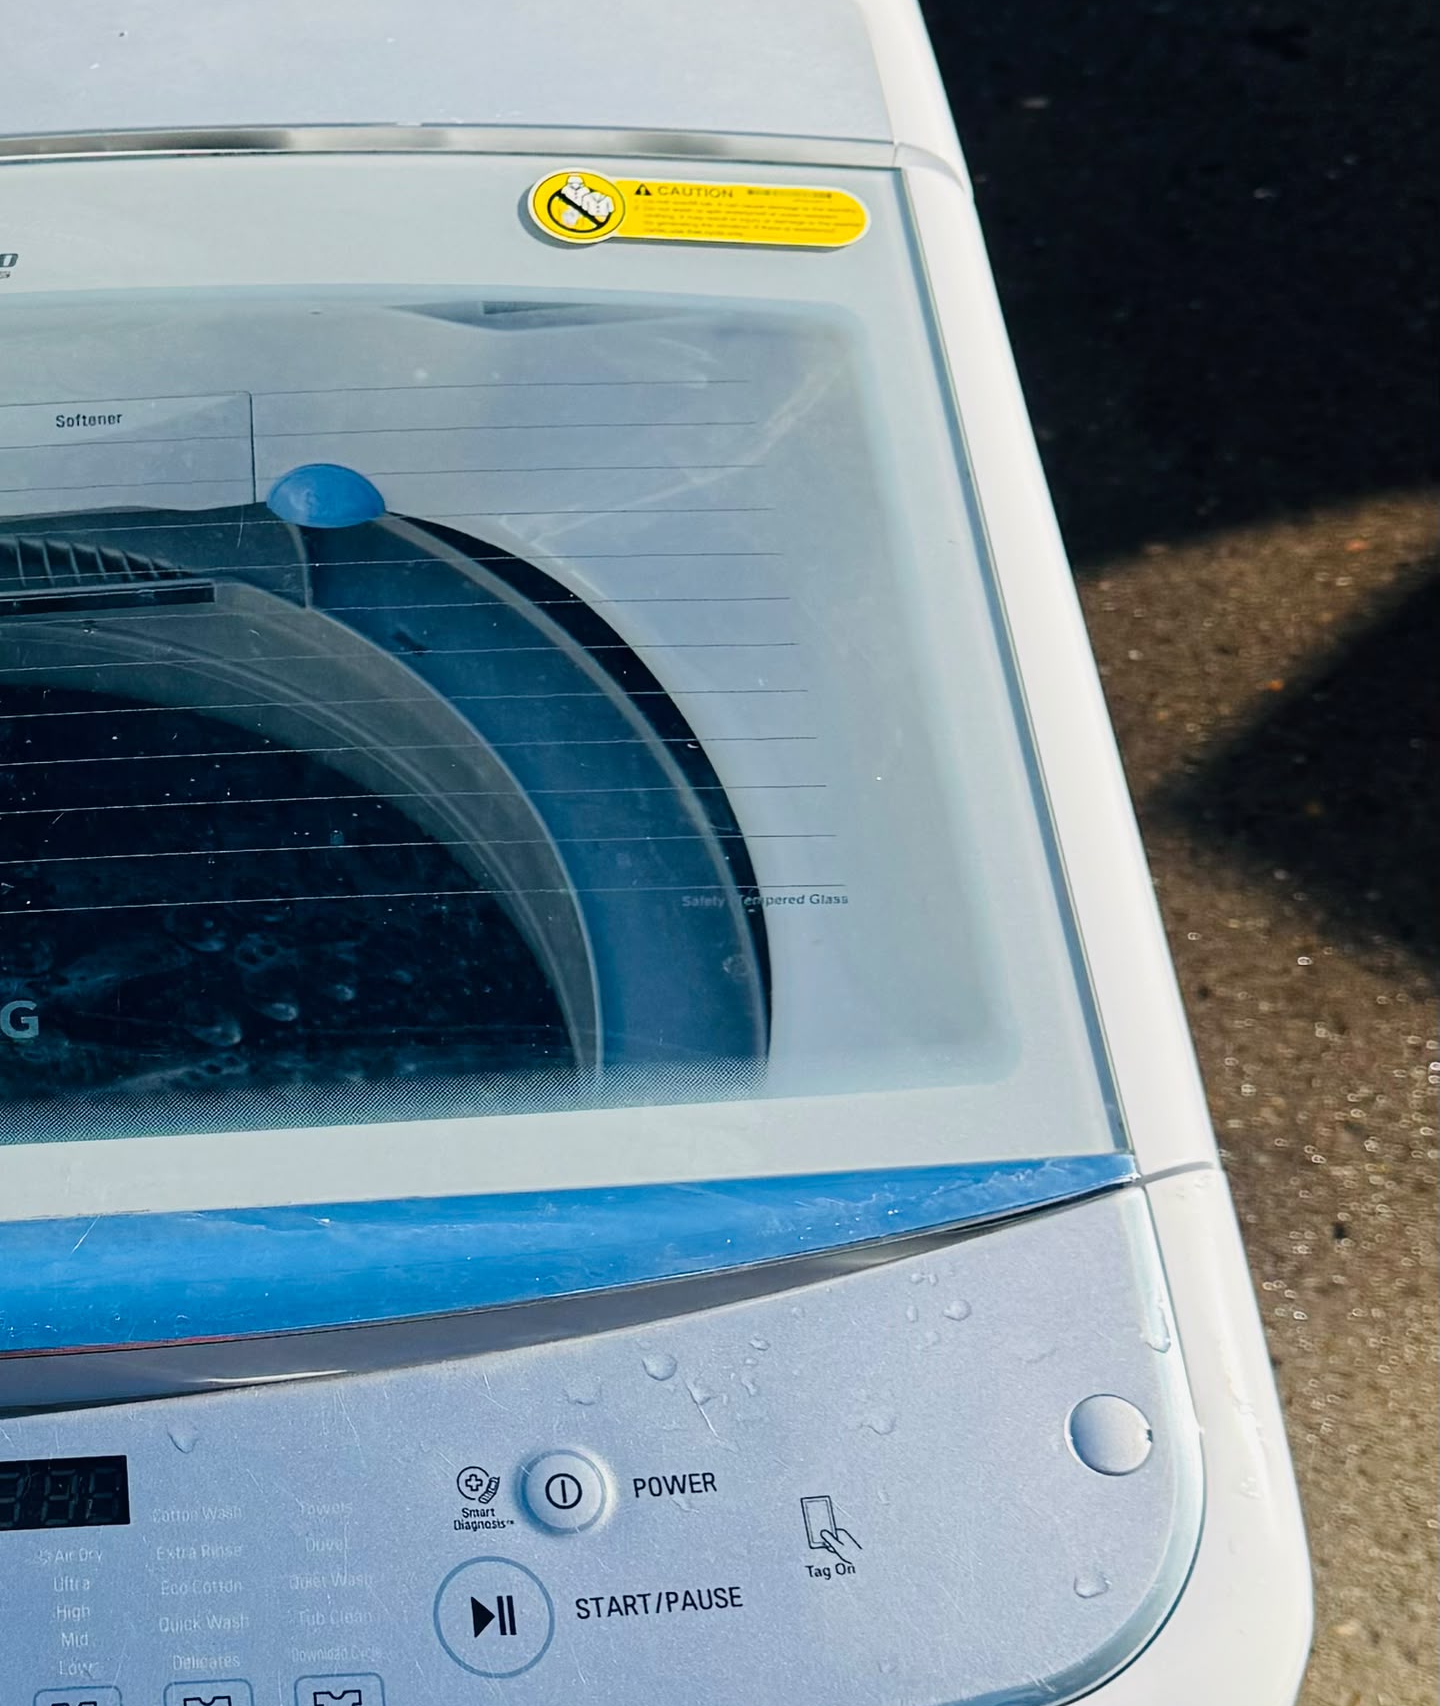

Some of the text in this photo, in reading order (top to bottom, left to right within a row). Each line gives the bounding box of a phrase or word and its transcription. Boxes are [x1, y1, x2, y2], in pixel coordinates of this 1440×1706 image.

[657, 186, 733, 198] CAUTION
[56, 412, 123, 429] Softener
[682, 895, 725, 908] Safety
[809, 894, 849, 905] Glass
[633, 1472, 717, 1498] POWER
[152, 1505, 242, 1523] Cotton Wash
[300, 1501, 352, 1515] Towels
[462, 1507, 495, 1519] Smart
[55, 1548, 102, 1564] Air Dry
[156, 1544, 242, 1561] Extra Rinse
[331, 1572, 372, 1587] Wash
[805, 1563, 856, 1580] Tag On
[53, 1576, 90, 1592] Ultra
[161, 1579, 242, 1595] Eco Cotton
[575, 1587, 744, 1621] START/PAUSE
[56, 1605, 91, 1622] High
[299, 1609, 372, 1625] Tub Clean
[160, 1614, 249, 1634] Quick Wash
[61, 1632, 88, 1647] Mid
[59, 1661, 92, 1676] Low
[172, 1654, 241, 1671] Delicates
